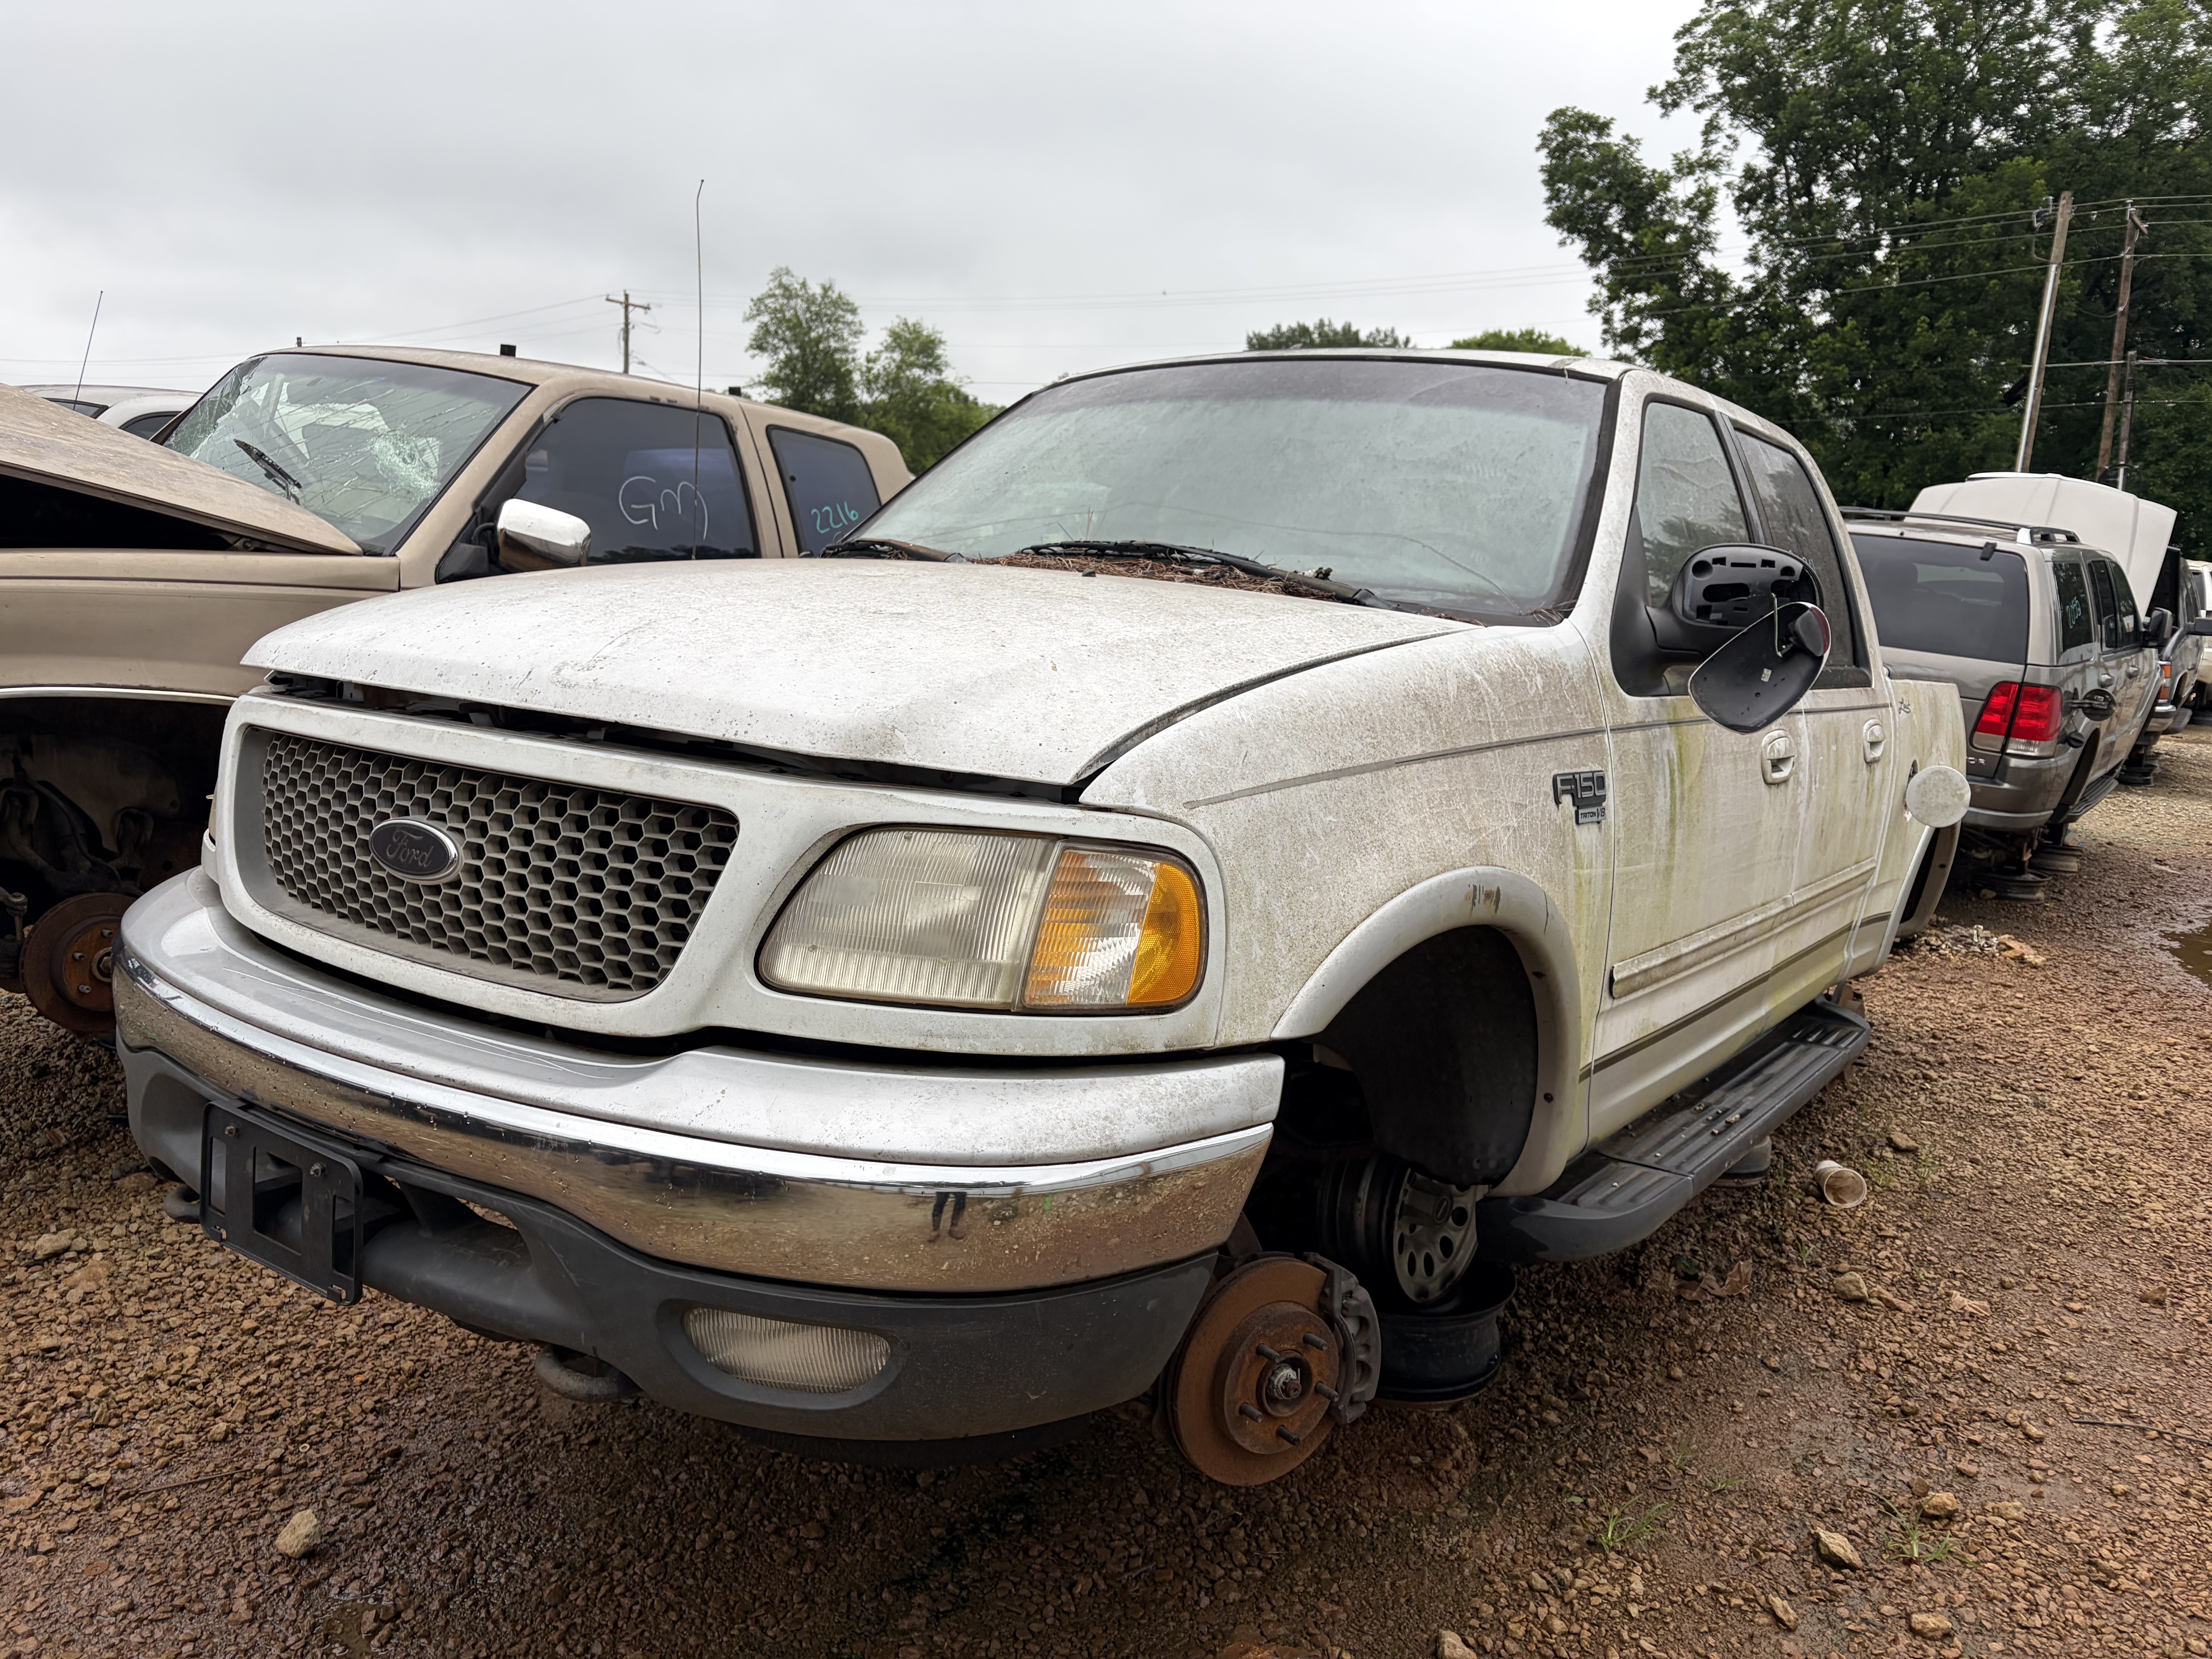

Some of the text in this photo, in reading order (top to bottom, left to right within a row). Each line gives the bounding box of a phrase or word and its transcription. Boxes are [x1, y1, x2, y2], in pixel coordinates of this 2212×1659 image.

[811, 501, 859, 534] 2216
[1597, 807, 1605, 819] V8
[386, 829, 434, 867] Ford
